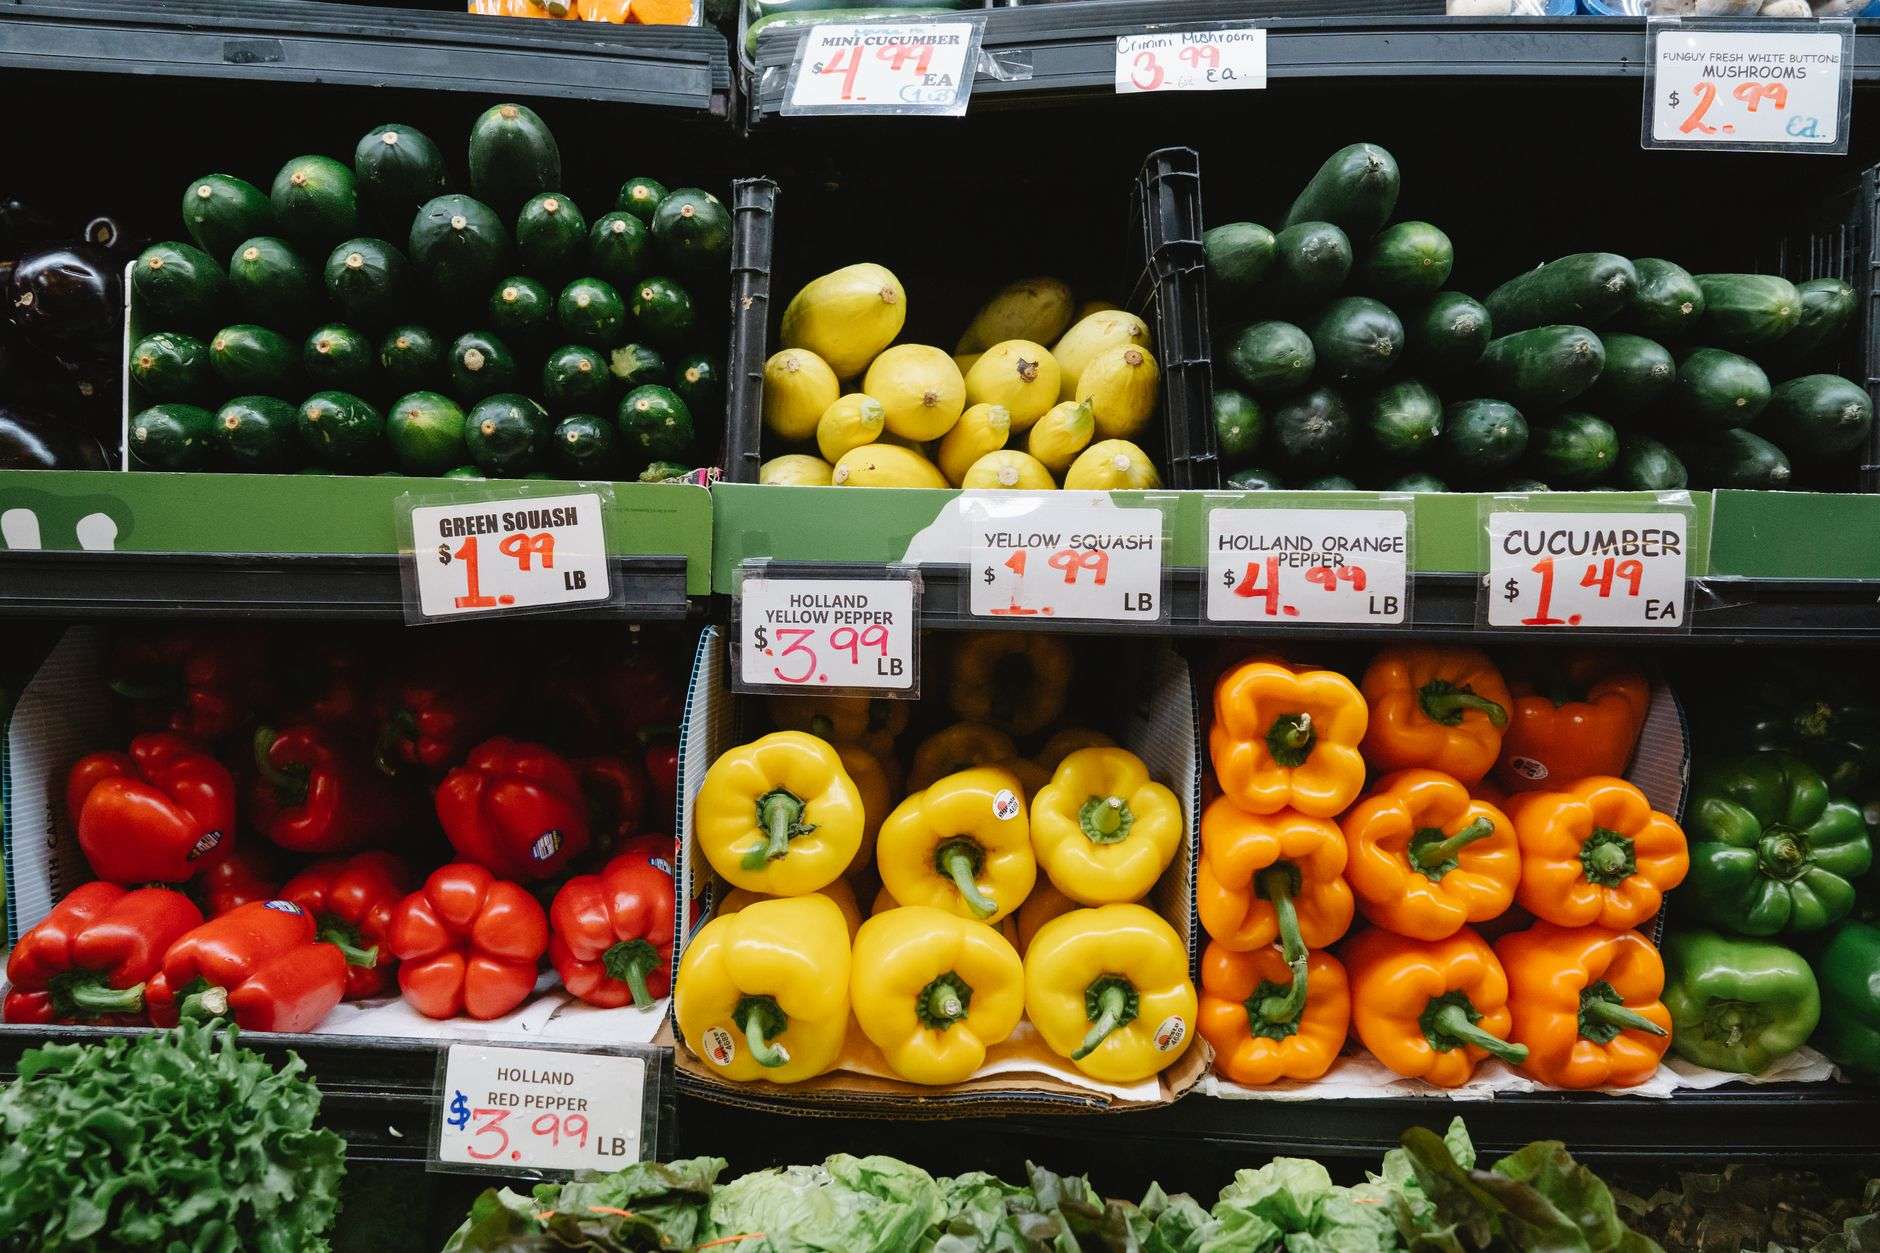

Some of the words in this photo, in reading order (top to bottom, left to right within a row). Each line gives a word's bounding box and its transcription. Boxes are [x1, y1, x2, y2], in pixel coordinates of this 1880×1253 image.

[822, 36, 859, 47] MINI
[864, 34, 960, 46] CUCUMBER
[1182, 31, 1254, 45] Mushroom
[1663, 52, 1706, 62] FUNGUY
[1709, 52, 1744, 62] FRESH
[1748, 53, 1785, 63] WHITE
[921, 73, 953, 86] EA
[1702, 65, 1807, 79] MUSHROOMS
[439, 512, 499, 538] GREEN
[985, 532, 1061, 549] YELLOW
[1069, 534, 1153, 552] SQUASH
[1218, 535, 1313, 551] HOLLAND
[1322, 536, 1404, 553] ORANGE
[1503, 528, 1681, 556] CUCUMBER
[1278, 552, 1345, 568] PEPPER
[563, 570, 587, 591] LB
[790, 594, 868, 609] HOLLAND
[1124, 592, 1153, 612] LB
[1369, 595, 1398, 615] LB
[1644, 599, 1676, 620] EA
[766, 610, 829, 624] YELLOW
[834, 611, 894, 625] PEPPER
[877, 657, 904, 676] LB
[497, 1067, 575, 1086] HOLLAND
[488, 1092, 520, 1107] RED
[524, 1094, 589, 1112] PEPPER
[597, 1136, 626, 1156] LB
